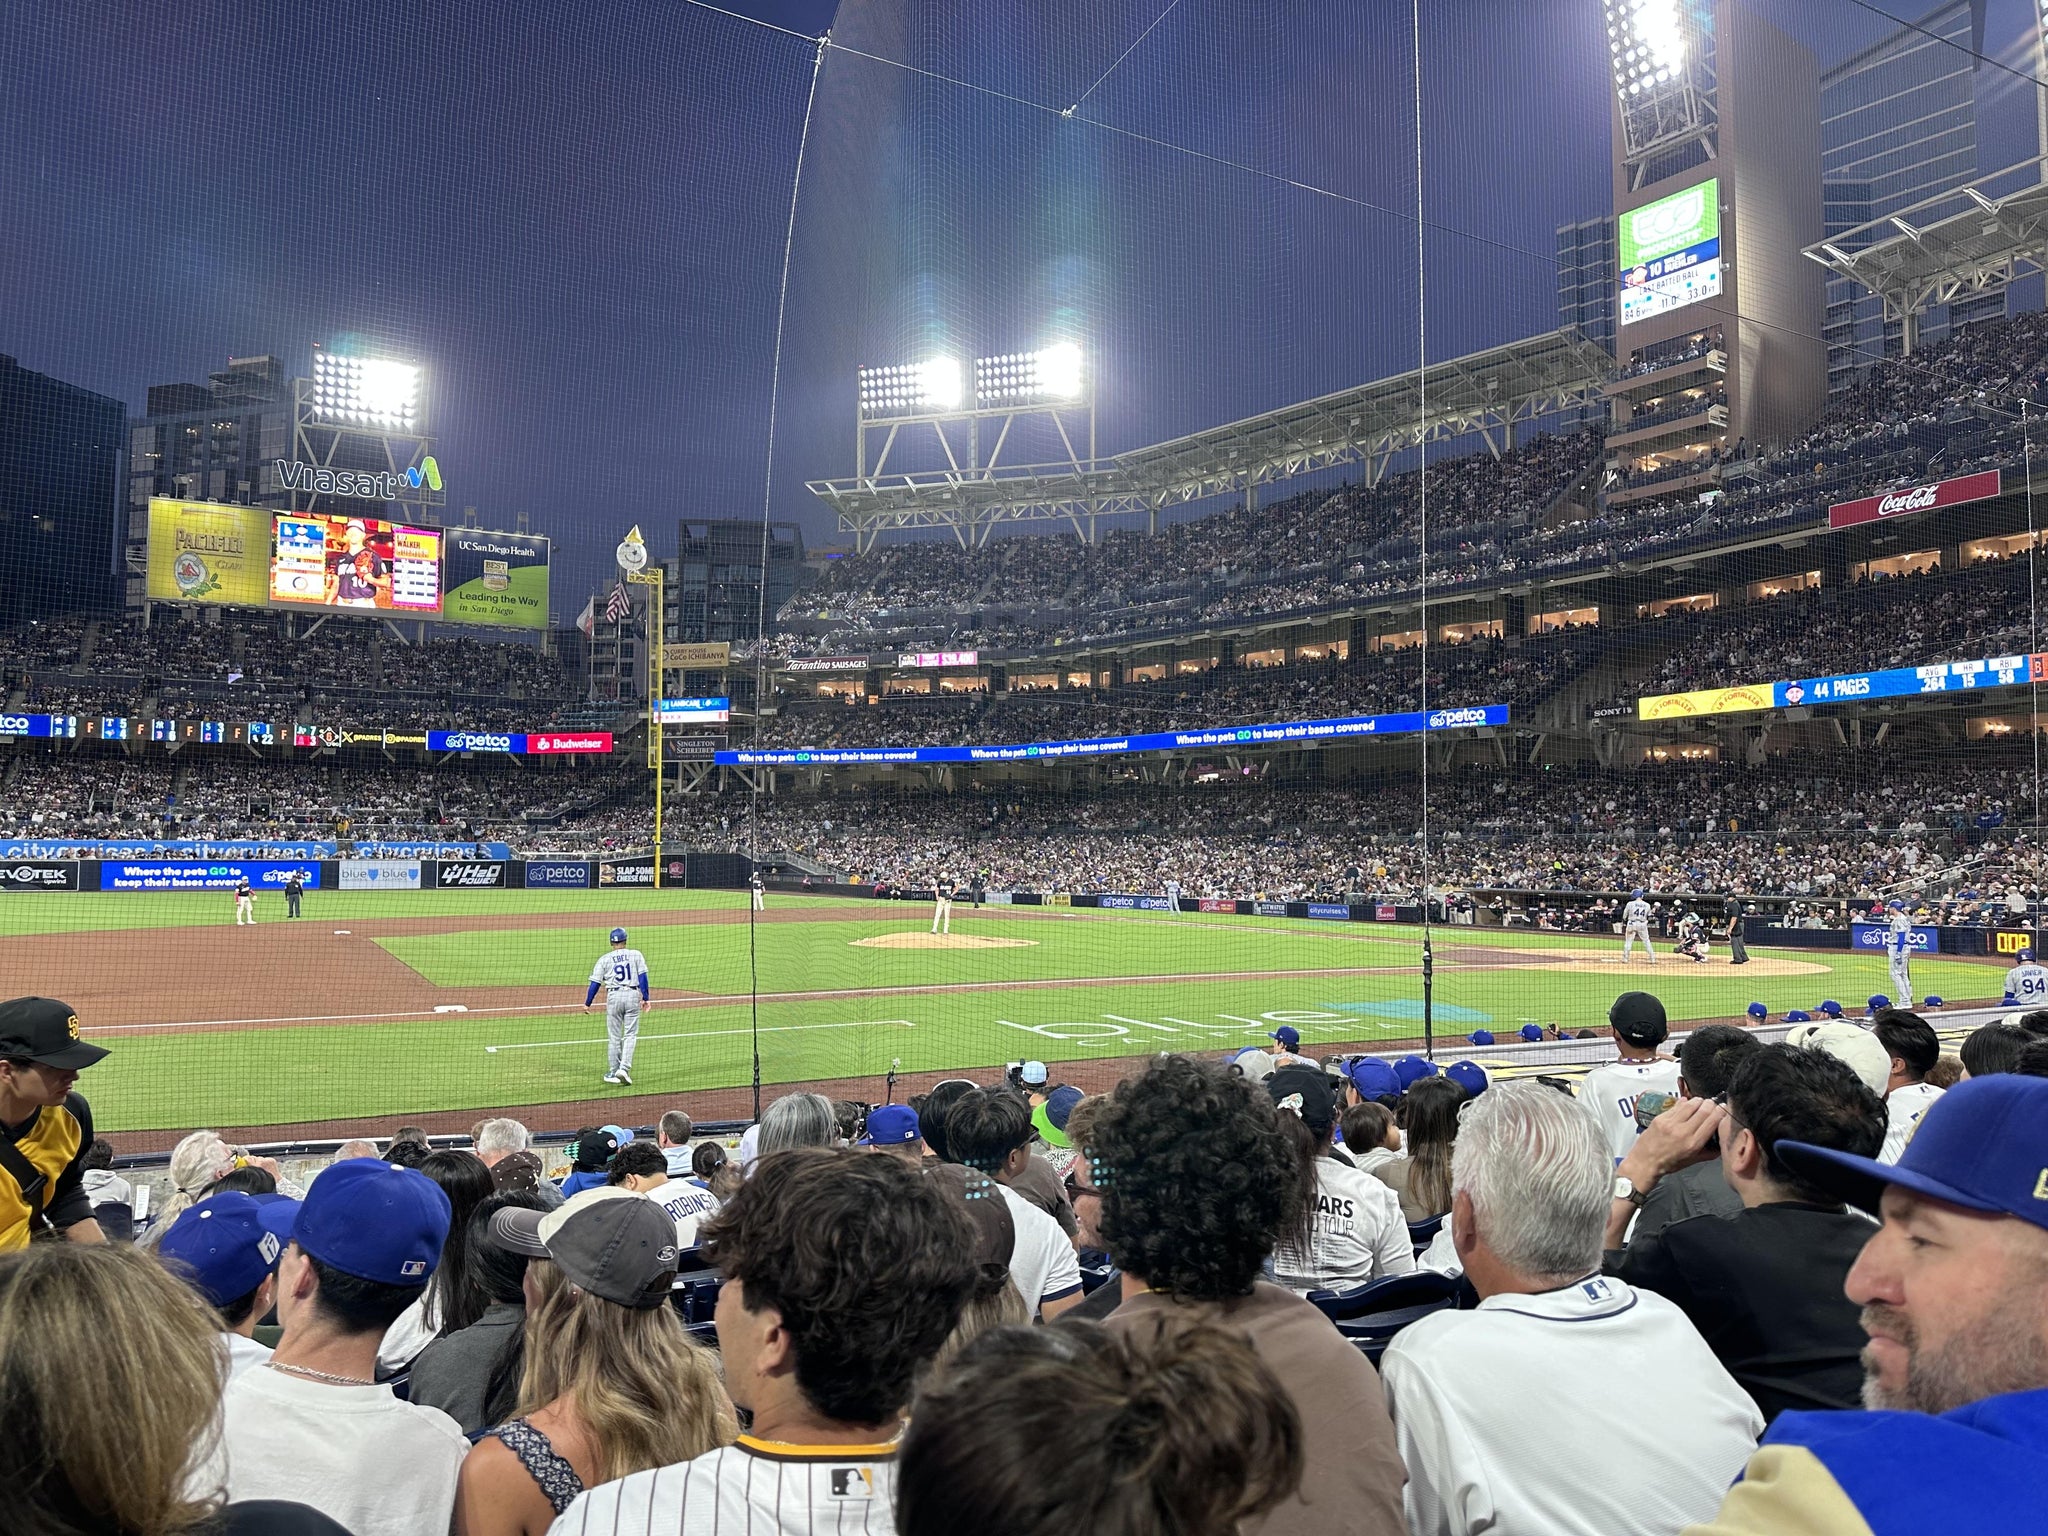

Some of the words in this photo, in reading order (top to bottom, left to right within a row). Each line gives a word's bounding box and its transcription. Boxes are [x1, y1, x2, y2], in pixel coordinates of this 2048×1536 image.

[1650, 262, 1661, 277] 10
[1657, 275, 1680, 290] BATTED
[1682, 269, 1698, 280] BALL
[276, 459, 395, 500] Viasat
[1878, 485, 1939, 516] Coca-Cola
[459, 540, 472, 550] UC
[472, 542, 487, 552] San
[488, 544, 510, 556] Diego
[510, 546, 535, 556] Health
[486, 562, 506, 570] BEST
[460, 592, 498, 603] Leading
[501, 594, 516, 604] the
[518, 596, 538, 607] Way
[459, 603, 468, 612] in
[470, 604, 487, 614] San
[490, 606, 514, 616] Diego
[786, 660, 830, 670] Tarantino
[832, 660, 866, 668] SAUSAGES
[1925, 668, 1939, 677] AVG
[1963, 663, 1974, 672] HR
[1962, 674, 1975, 688] 15
[1814, 683, 1828, 698] 44
[1834, 678, 1870, 697] PAGES
[1446, 708, 1486, 726] petco
[1594, 708, 1622, 718] SONY
[87, 722, 94, 734] F
[120, 718, 127, 728] 5
[137, 724, 144, 734] F
[119, 729, 126, 740] 4
[187, 726, 194, 736] F
[234, 728, 240, 738] F
[281, 730, 288, 740] F
[1176, 734, 1202, 744] Where
[1203, 734, 1216, 743] the
[1218, 732, 1236, 743] pets
[1237, 730, 1251, 740] GO
[1252, 730, 1262, 738] to
[1263, 728, 1284, 740] keep
[1286, 726, 1306, 736] their
[1308, 724, 1334, 735] bases
[1336, 720, 1375, 732] covered
[466, 734, 510, 749] petco
[552, 739, 602, 748] Budweiser
[971, 749, 998, 758] Where
[1000, 748, 1012, 758] the
[1013, 749, 1027, 758] pets
[1028, 747, 1038, 756] GO
[1039, 747, 1046, 755] to
[1046, 746, 1062, 756] keep
[1063, 744, 1078, 753] their
[1080, 742, 1098, 752] bases
[1100, 740, 1128, 750] covered
[738, 754, 763, 762] Where
[764, 753, 777, 762] the
[778, 754, 796, 763] pets
[796, 752, 810, 762] GO
[810, 753, 820, 761] to
[820, 752, 840, 763] keep
[840, 752, 860, 761] their
[860, 752, 884, 760] bases
[884, 750, 917, 760] covered
[124, 866, 162, 876] Where
[163, 866, 181, 876] the
[183, 867, 207, 878] pets
[210, 866, 228, 876] GO
[229, 867, 242, 876] to
[342, 868, 367, 878] blue
[382, 868, 407, 878] blue
[462, 864, 502, 878] H2O
[546, 865, 585, 878] petco
[616, 866, 634, 874] SLAP
[114, 878, 143, 888] keep
[144, 877, 170, 886] their
[172, 878, 204, 887] bases
[205, 878, 243, 887] covere
[616, 874, 638, 882] CHEESE
[638, 874, 648, 882] ON
[1112, 897, 1134, 906] petco
[1634, 908, 1646, 917] 44
[1882, 930, 1928, 945] pco
[612, 954, 629, 963] EBEL
[614, 963, 632, 982] 91
[2022, 978, 2046, 994] 94
[994, 1010, 1361, 1039] blue
[664, 1194, 720, 1222] ROBINSO
[1324, 1215, 1354, 1238] TOUR
